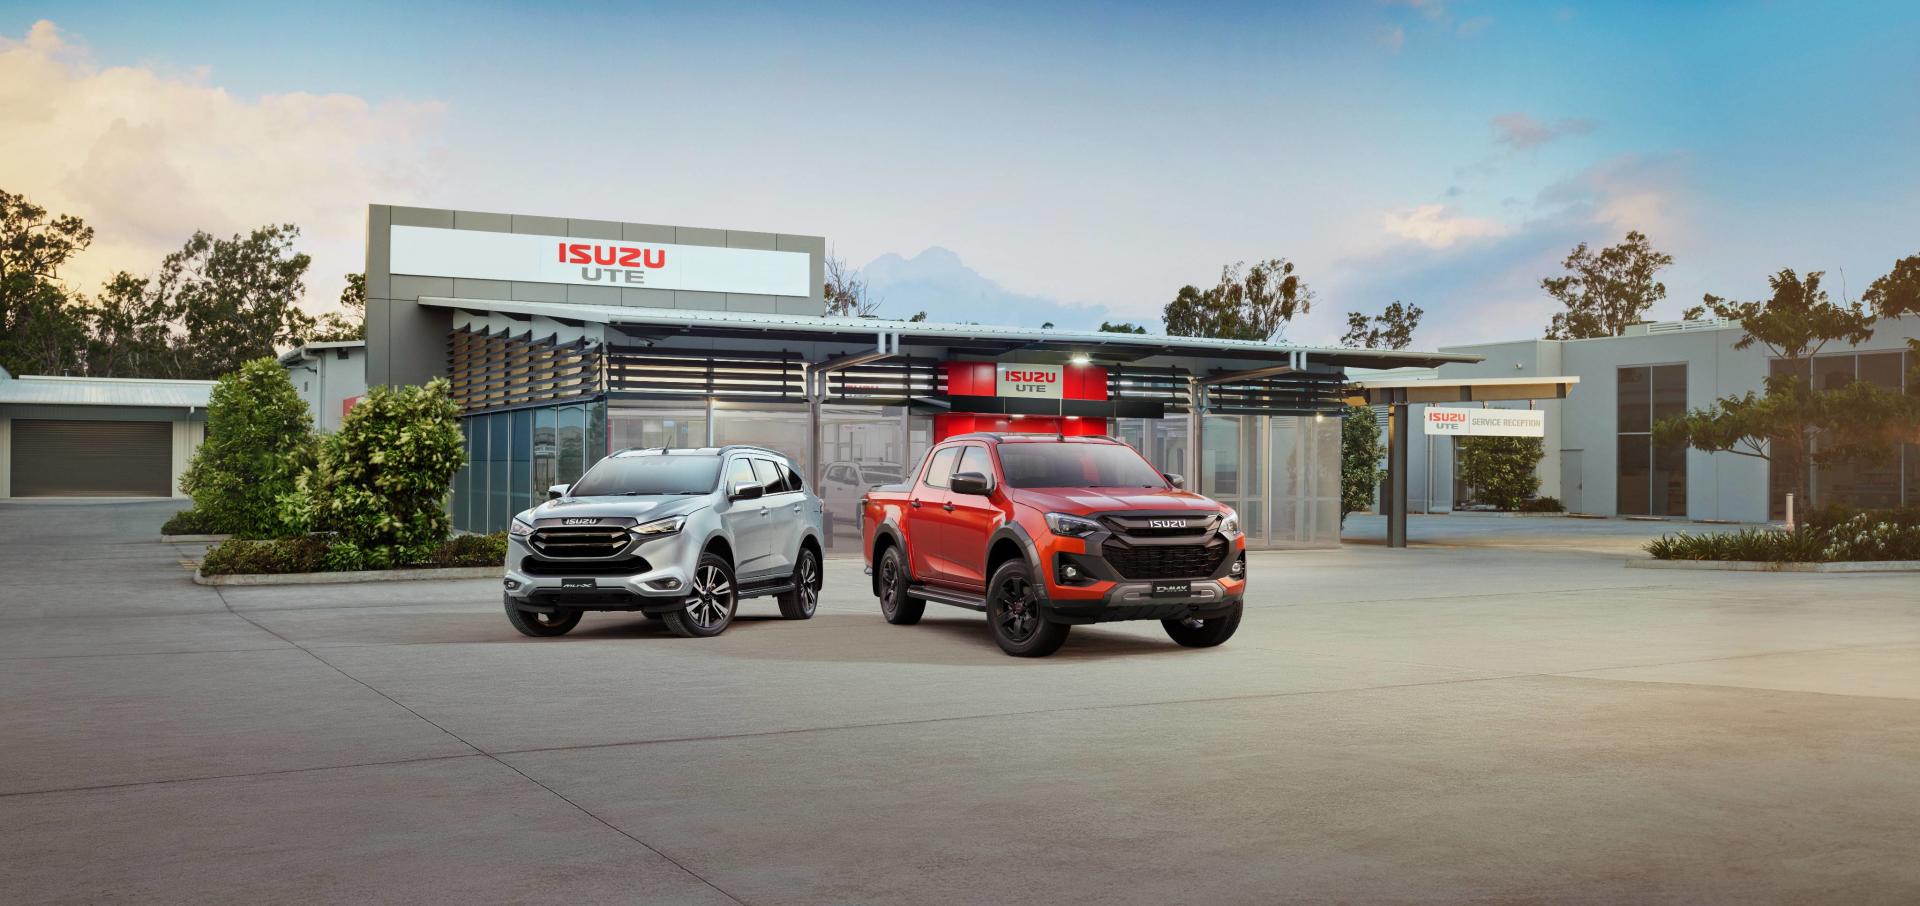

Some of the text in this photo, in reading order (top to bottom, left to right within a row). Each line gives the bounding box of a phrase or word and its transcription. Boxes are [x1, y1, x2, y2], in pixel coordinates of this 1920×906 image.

[559, 243, 665, 269] ISUZU
[582, 267, 645, 284] UTE
[1005, 371, 1056, 383] ISUZU
[1016, 384, 1046, 392] UTE
[1429, 412, 1466, 422] ISUZU
[1472, 418, 1541, 428] SERVICE RECEPTION
[1149, 520, 1186, 528] ISUZU
[1156, 585, 1188, 593] D-MAX
